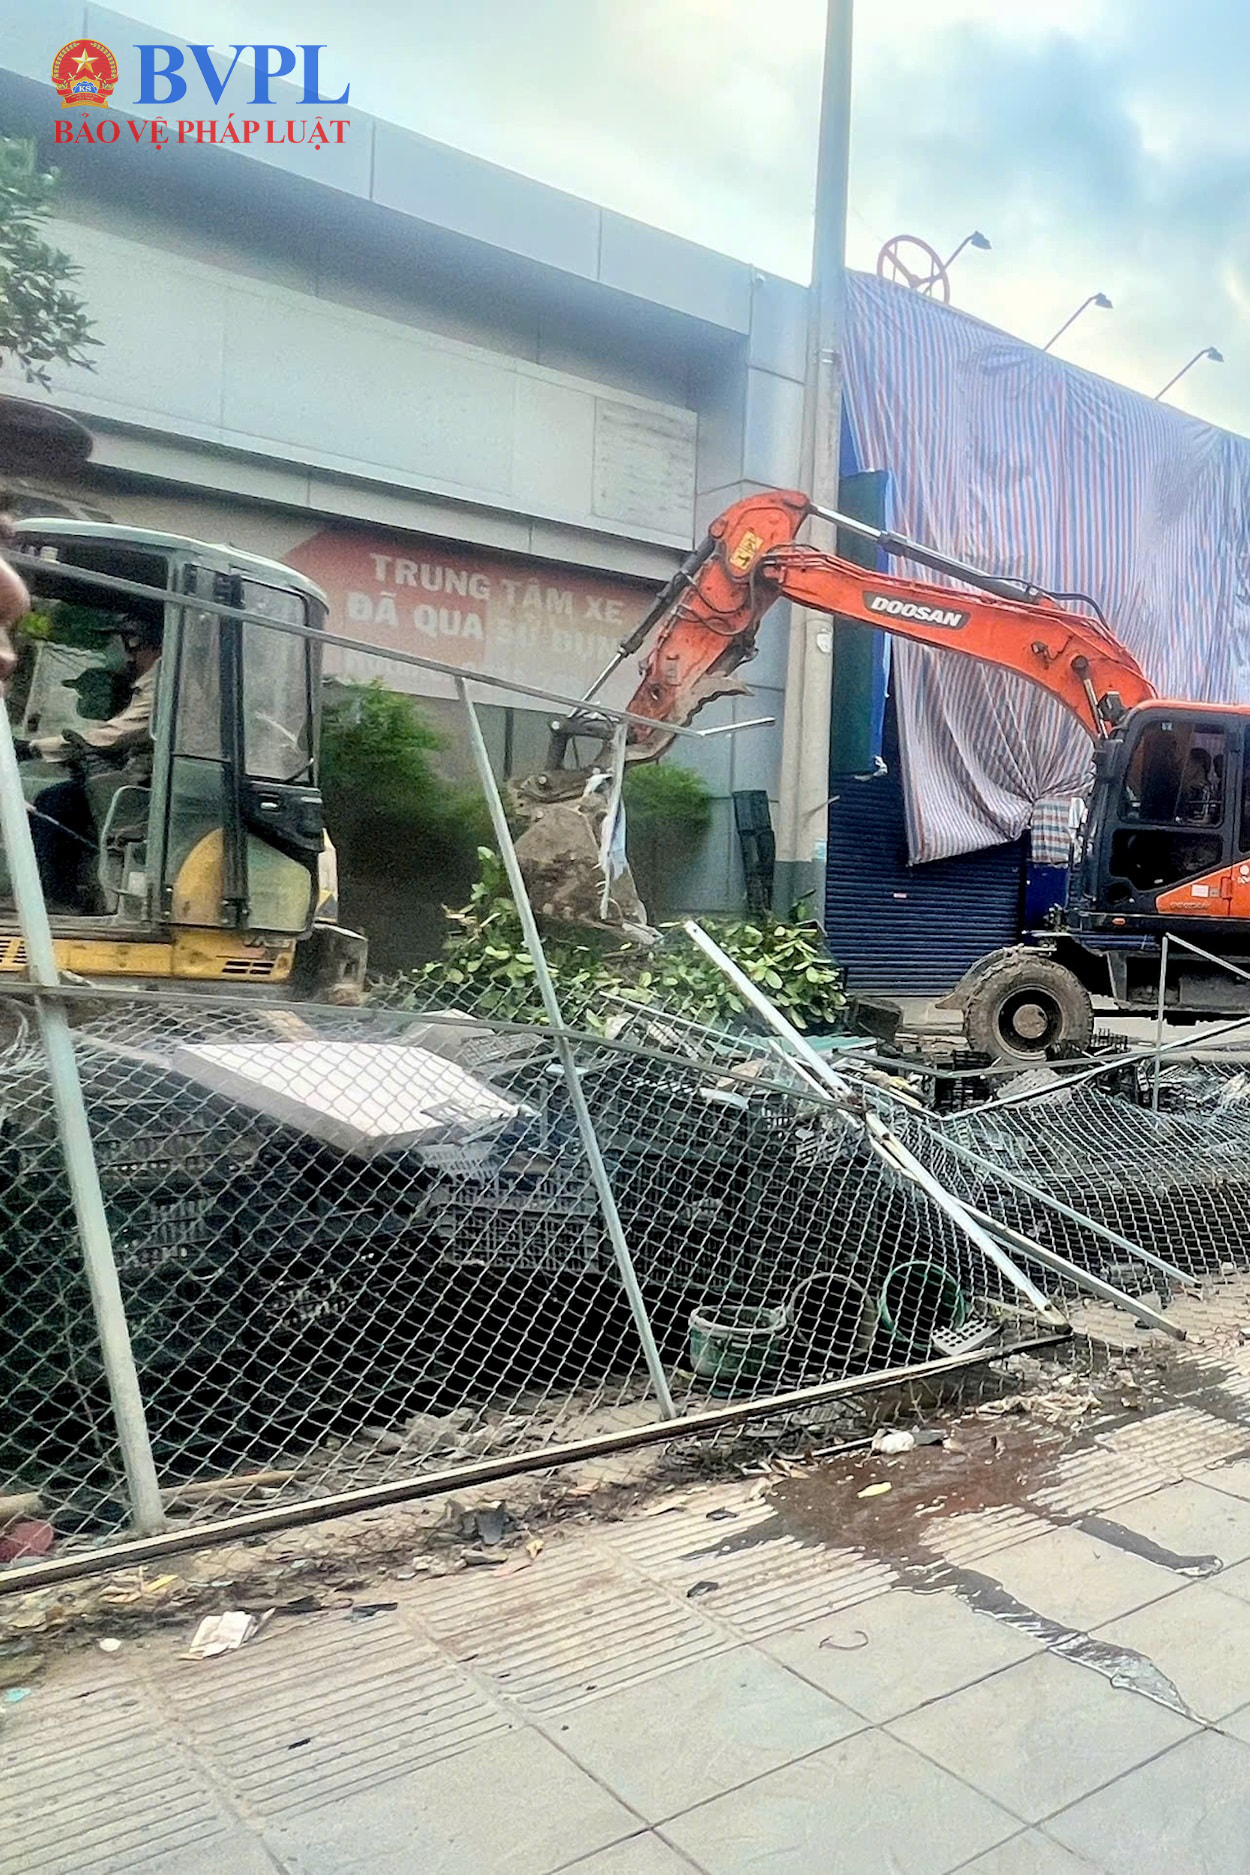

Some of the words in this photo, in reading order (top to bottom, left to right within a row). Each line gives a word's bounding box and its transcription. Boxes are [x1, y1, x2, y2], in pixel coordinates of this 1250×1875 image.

[370, 552, 491, 601] TRUNG
[502, 577, 573, 615] TÂM
[584, 594, 625, 625] XE
[871, 596, 962, 627] DOOSAN
[347, 591, 398, 628] ĐÃ
[414, 604, 484, 641] QUA
